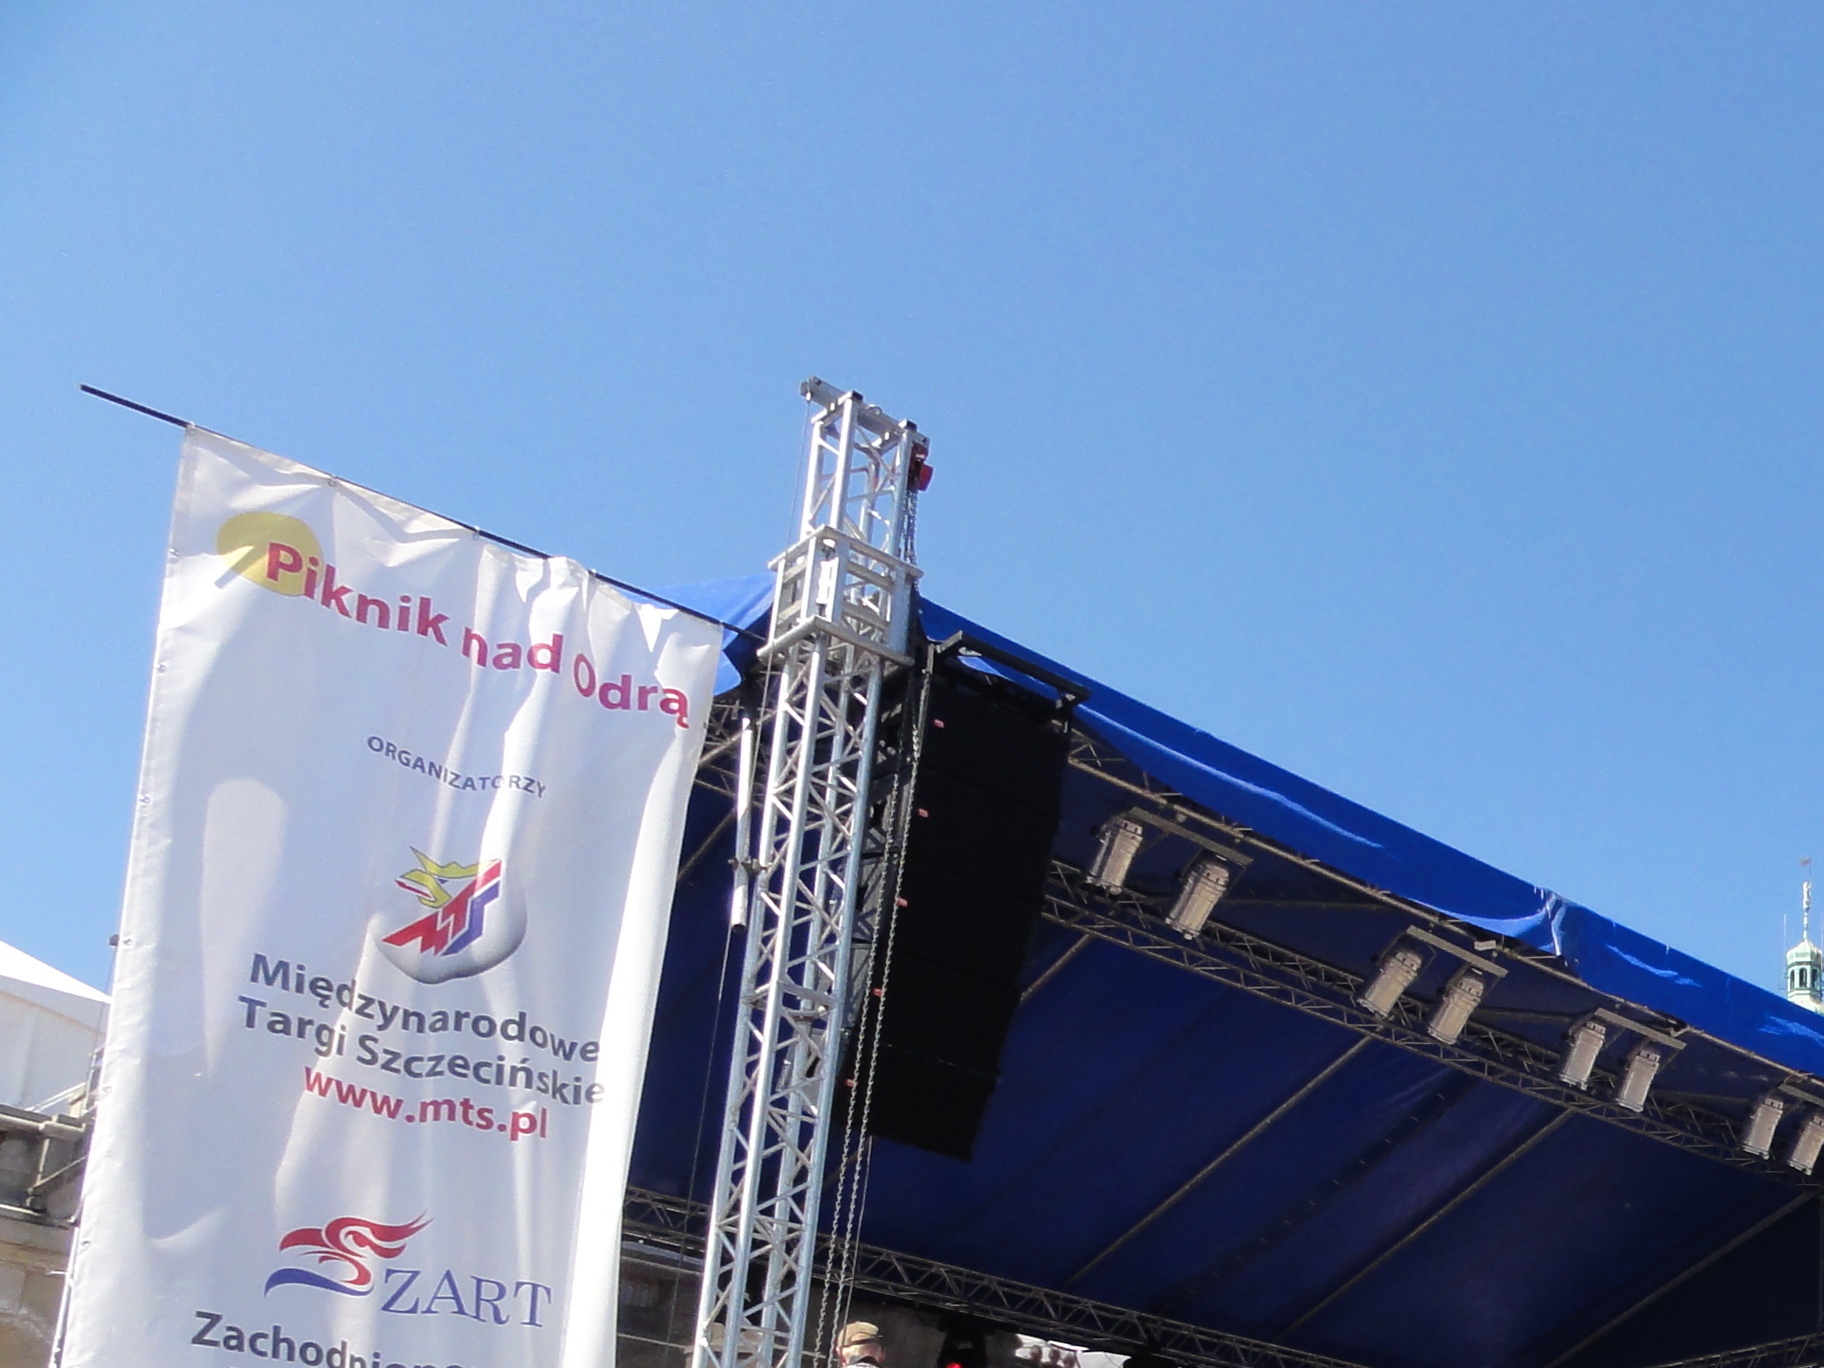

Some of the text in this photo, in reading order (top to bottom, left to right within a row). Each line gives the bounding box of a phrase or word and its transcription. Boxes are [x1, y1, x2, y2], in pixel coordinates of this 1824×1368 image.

[266, 541, 690, 728] Piknik nad Odrą
[367, 735, 547, 798] ORGANIZATORZY
[239, 995, 605, 1105] Targi Szczecińskie
[250, 953, 600, 1062] Międzynarodowe
[304, 1064, 548, 1141] www.mts.pl
[382, 1268, 552, 1328] ZART
